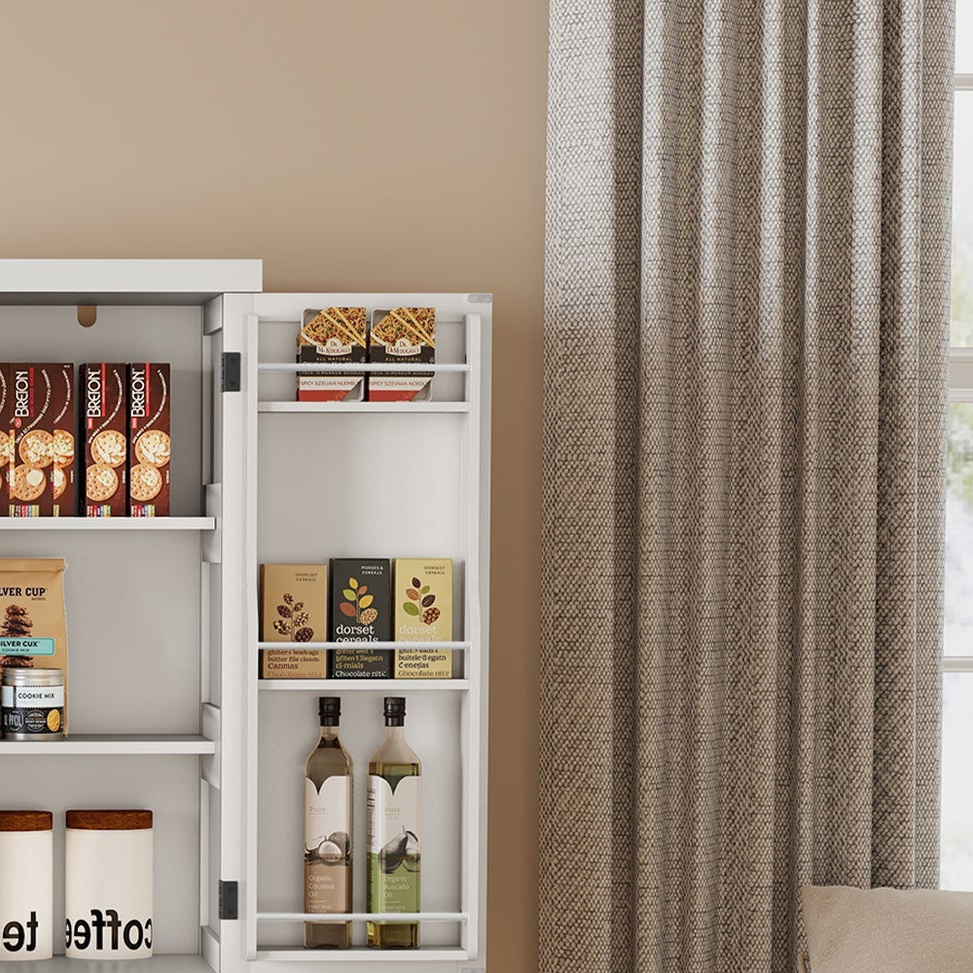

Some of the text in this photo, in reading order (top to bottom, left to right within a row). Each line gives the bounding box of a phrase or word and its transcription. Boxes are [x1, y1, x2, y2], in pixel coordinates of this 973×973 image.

[25, 587, 46, 596] CUP
[336, 624, 375, 635] dorset
[399, 624, 436, 635] dorset
